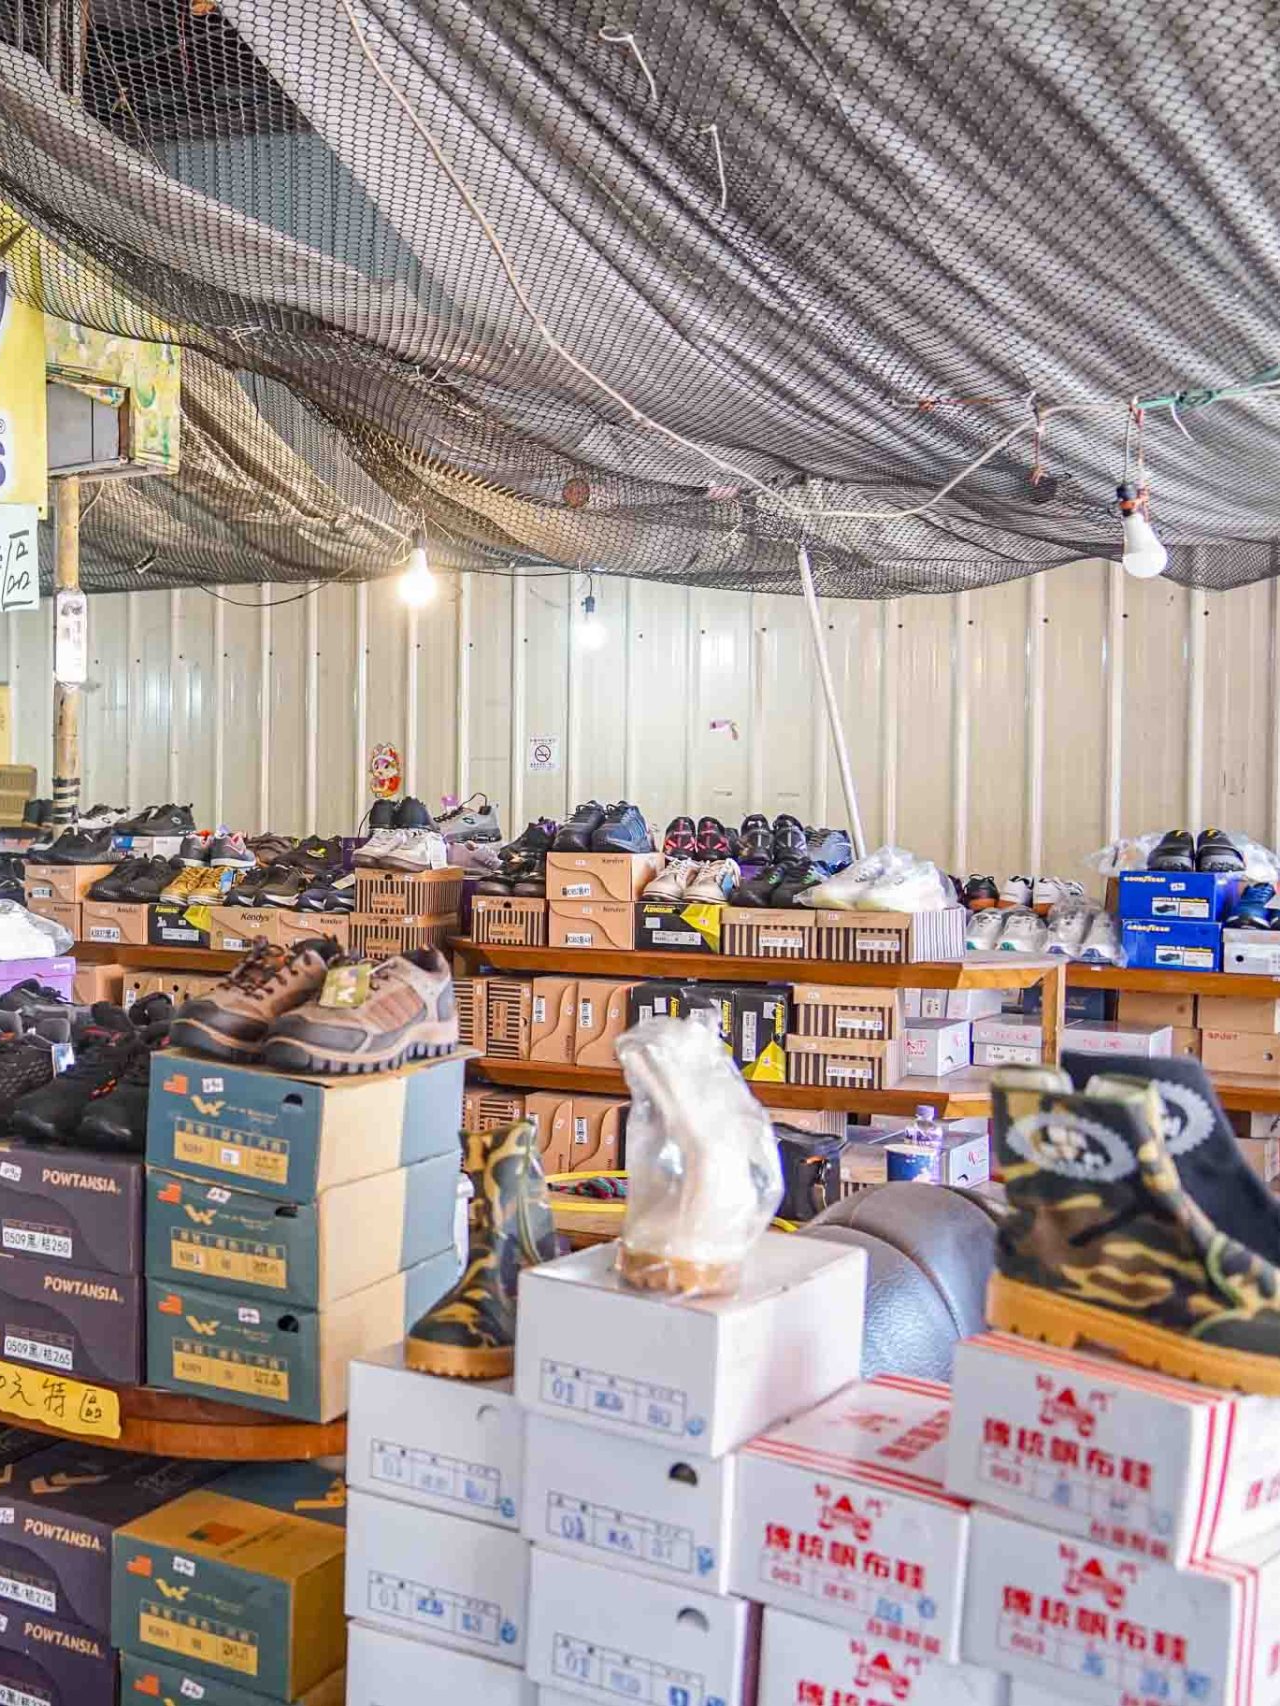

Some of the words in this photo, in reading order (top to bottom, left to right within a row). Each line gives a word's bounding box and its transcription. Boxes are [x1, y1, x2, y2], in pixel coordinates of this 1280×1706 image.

[42, 1168, 117, 1193] POWTANSIA
[44, 1275, 119, 1301] POWTANSIA
[24, 1518, 102, 1550] POWTANSIA
[24, 1621, 102, 1656] POWTANSIA
